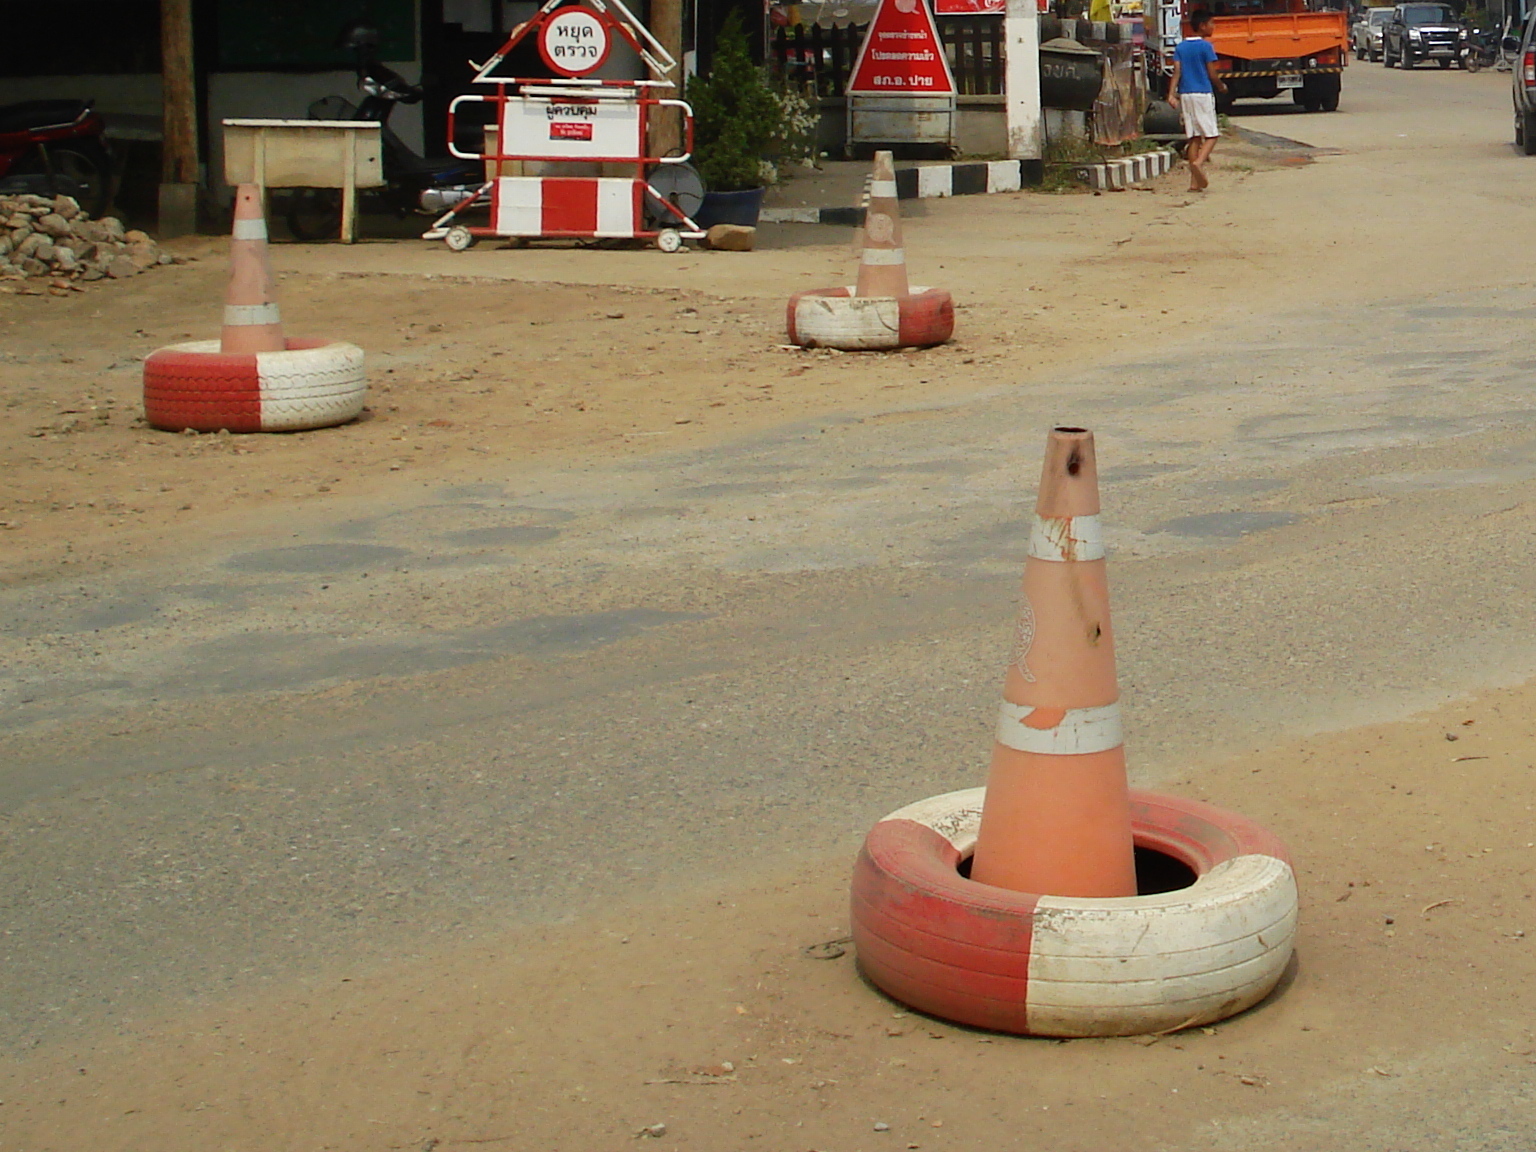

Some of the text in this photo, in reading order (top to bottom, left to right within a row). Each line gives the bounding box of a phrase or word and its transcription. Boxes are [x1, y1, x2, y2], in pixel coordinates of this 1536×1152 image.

[556, 25, 594, 44] หยุด
[554, 45, 598, 58] ตรวจ
[908, 74, 933, 87] ปาย
